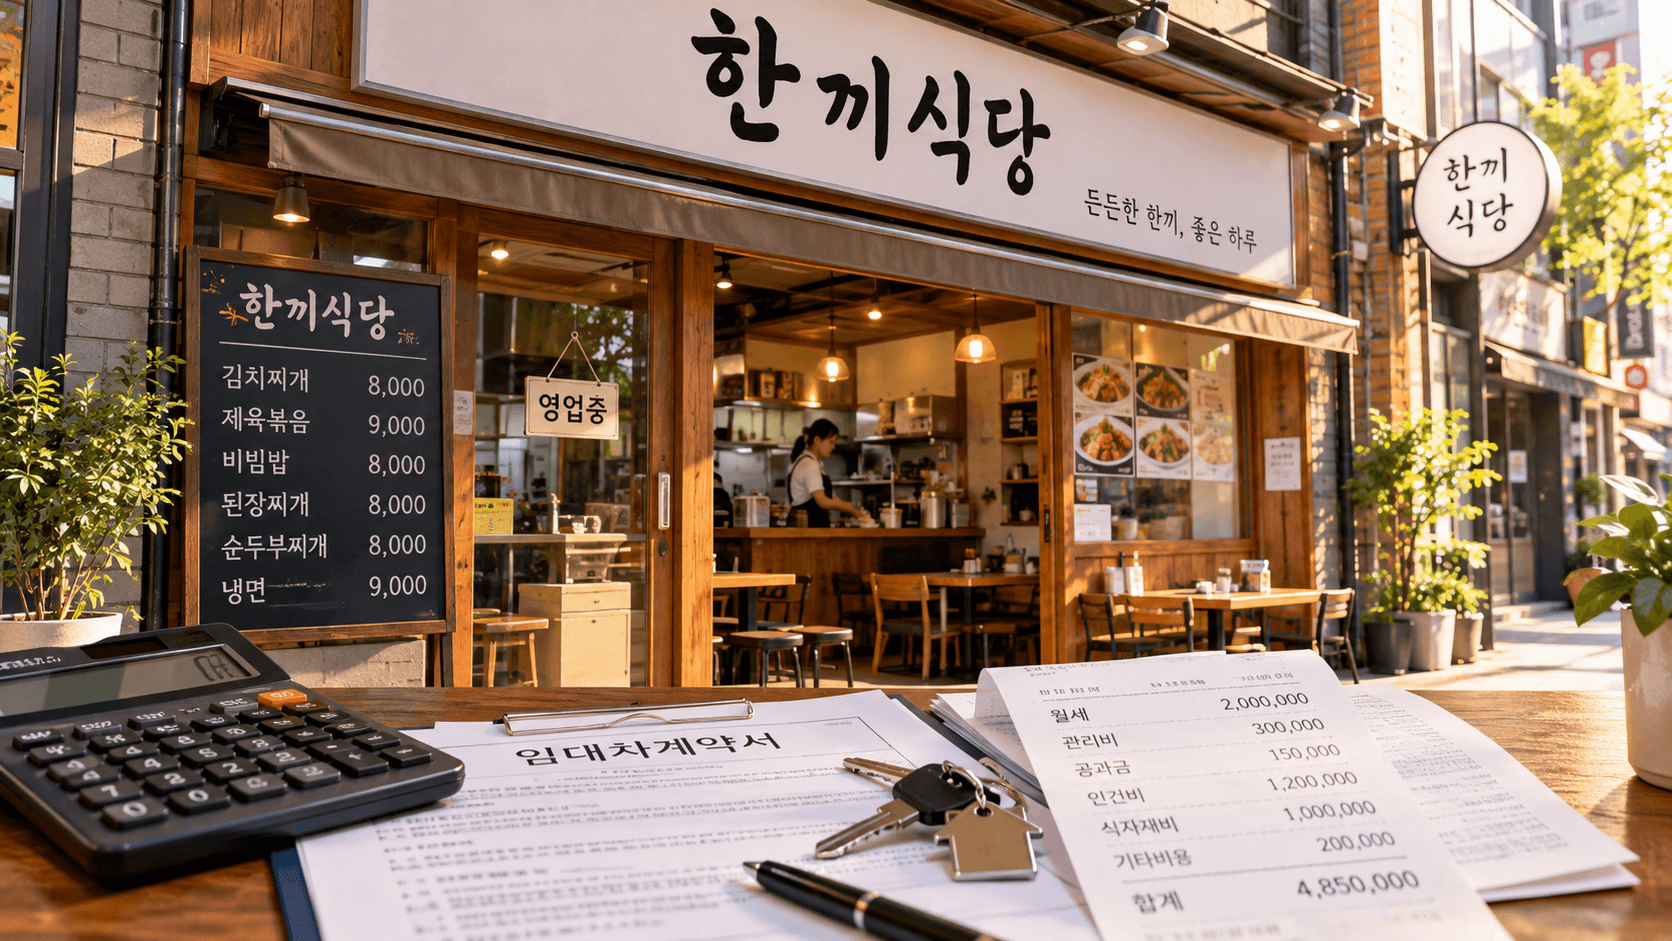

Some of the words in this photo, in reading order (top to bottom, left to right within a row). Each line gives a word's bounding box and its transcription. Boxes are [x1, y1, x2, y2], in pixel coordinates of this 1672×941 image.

[691, 8, 1050, 196] 한끼식당
[1443, 147, 1507, 192] 한끼
[1084, 188, 1139, 226] 든든한
[1146, 204, 1184, 239] 한끼,
[1190, 216, 1222, 246] 좋은
[1228, 226, 1257, 254] 하루
[1447, 192, 1514, 238] 식당
[239, 282, 396, 342] 한끼식당
[222, 363, 309, 393] 김치찌개
[368, 375, 425, 398] 8,000
[221, 406, 311, 434] 제육볶음
[368, 414, 425, 438] 9,000
[222, 448, 290, 475] 비빔밥
[368, 453, 426, 478] 8,000
[221, 491, 309, 518] 된장찌개
[368, 494, 426, 518] 8,000
[221, 533, 327, 561] 순두부찌개
[368, 534, 427, 558] 8,000
[221, 577, 266, 605] 냉면
[369, 574, 427, 600] 9,000
[1050, 707, 1090, 724] 월세
[1220, 692, 1309, 712] 2,000,000
[514, 731, 782, 767] 임대차계약서
[1062, 732, 1119, 750] 관리비
[1252, 718, 1325, 735] 300,000
[1075, 760, 1131, 778] 공과금
[1268, 743, 1341, 761] 150,000
[1087, 787, 1146, 807] 인건비
[1267, 771, 1358, 792] 1,200,000
[1101, 816, 1179, 837] 식자재비
[1283, 800, 1376, 821] 1,000,000
[1114, 849, 1192, 870] 기타비용
[1316, 831, 1396, 852] 200,000
[1132, 890, 1184, 914] 합계
[1297, 870, 1420, 899] 4,850,000
